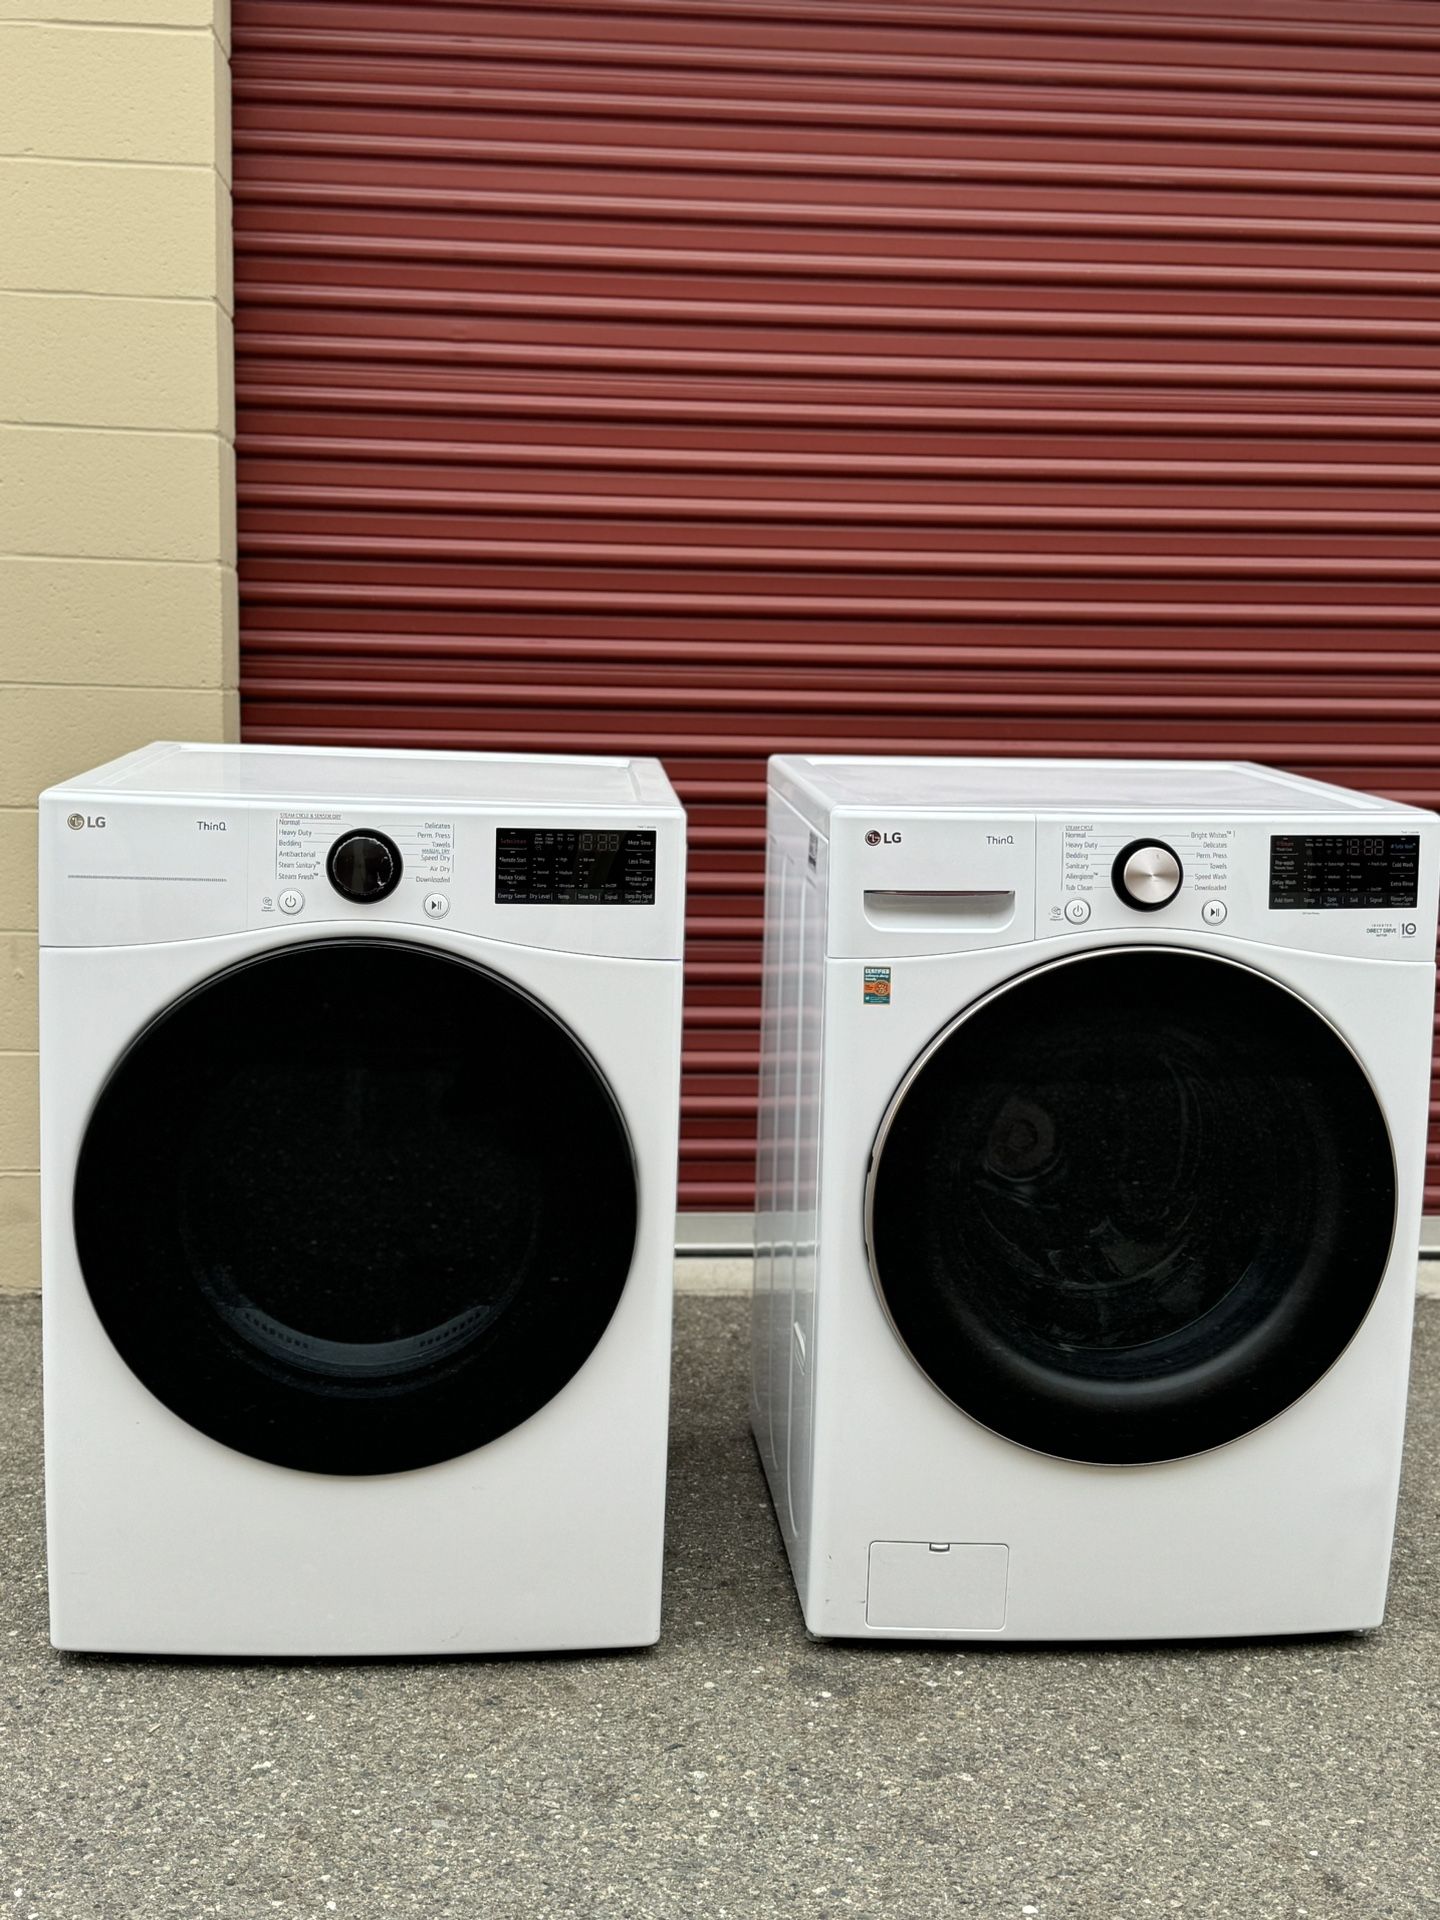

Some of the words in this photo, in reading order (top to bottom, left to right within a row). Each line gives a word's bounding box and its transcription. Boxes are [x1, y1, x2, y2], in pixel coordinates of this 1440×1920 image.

[87, 816, 106, 828] LG
[197, 821, 227, 831] ThinQ
[884, 832, 902, 844] LG
[986, 836, 1014, 845] ThinQ
[1191, 832, 1208, 840] Bright
[279, 840, 302, 848] Bedding
[1402, 922, 1416, 935] 10
